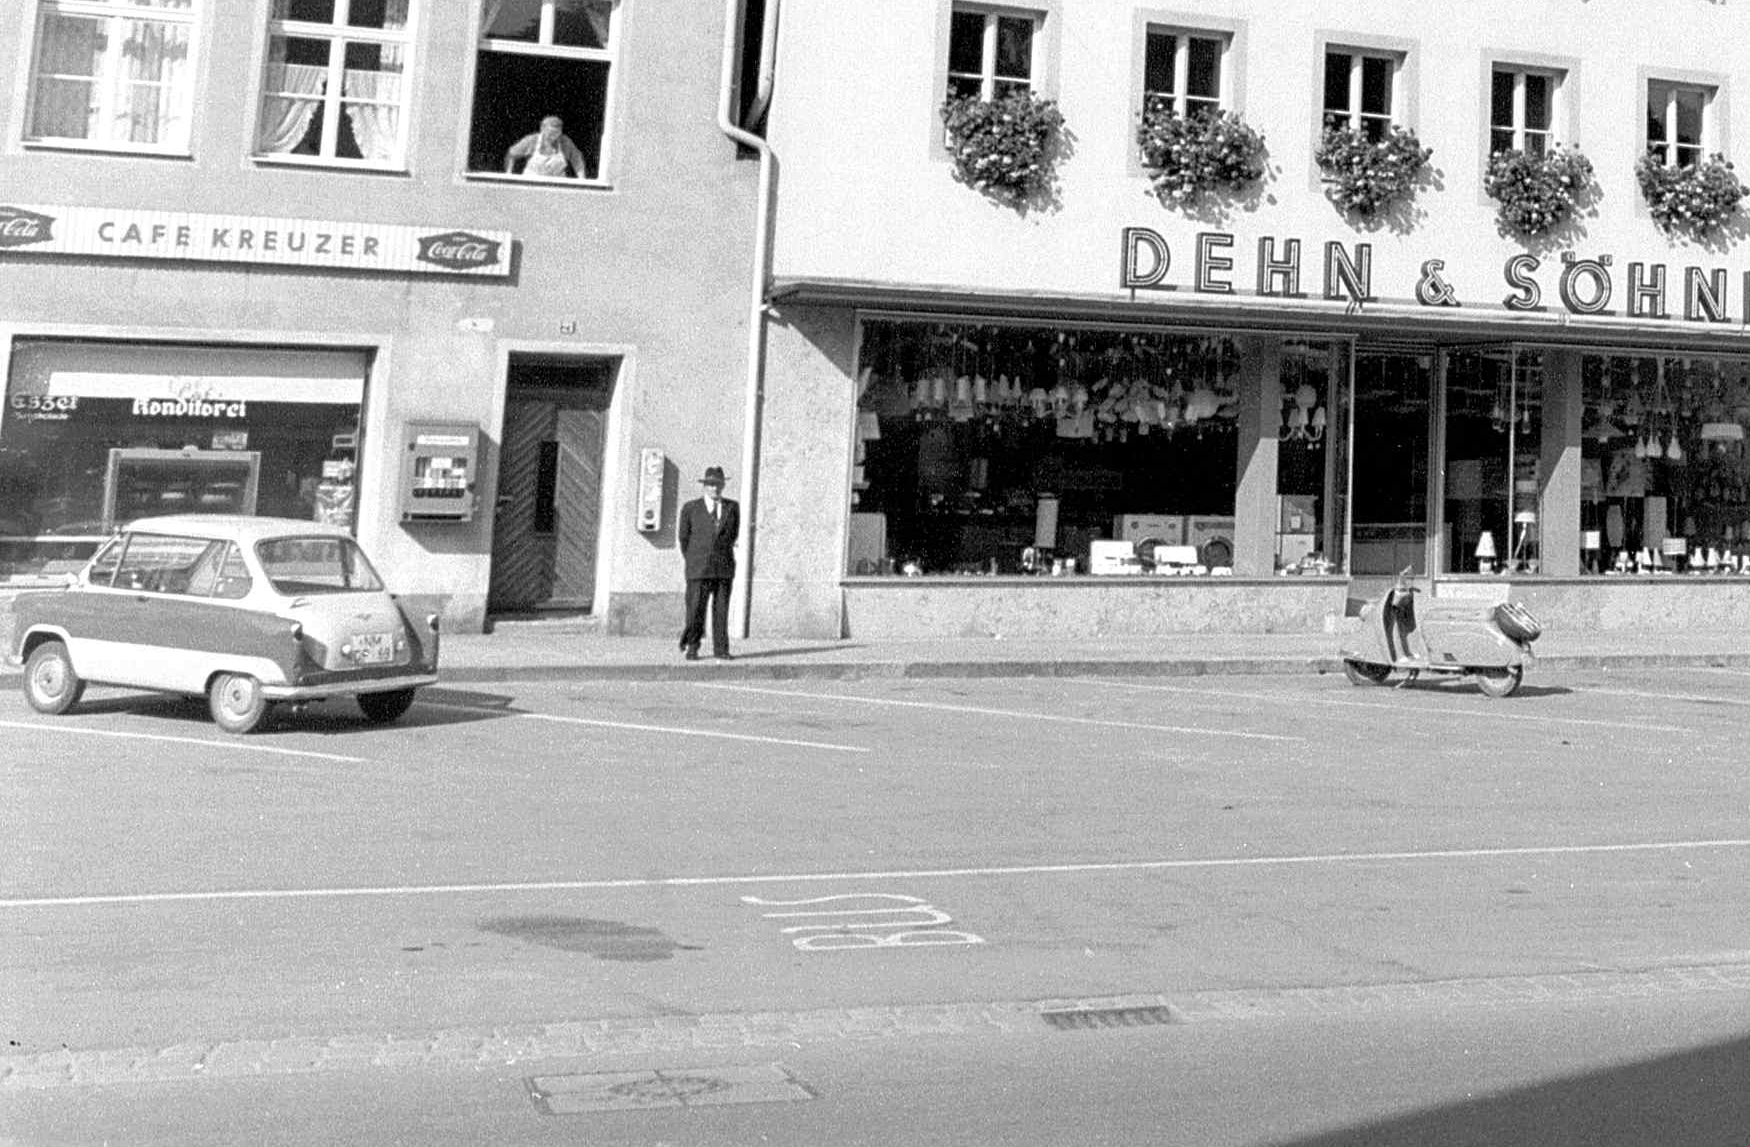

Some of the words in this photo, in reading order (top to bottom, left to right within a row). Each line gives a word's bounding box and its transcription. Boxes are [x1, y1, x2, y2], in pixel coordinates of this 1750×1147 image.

[98, 221, 191, 247] CAFE
[211, 228, 379, 256] KREUZER
[1121, 226, 1372, 300] DEHN
[1415, 259, 1458, 305] &
[132, 395, 246, 418] Konditorei
[740, 892, 986, 952] BUS
